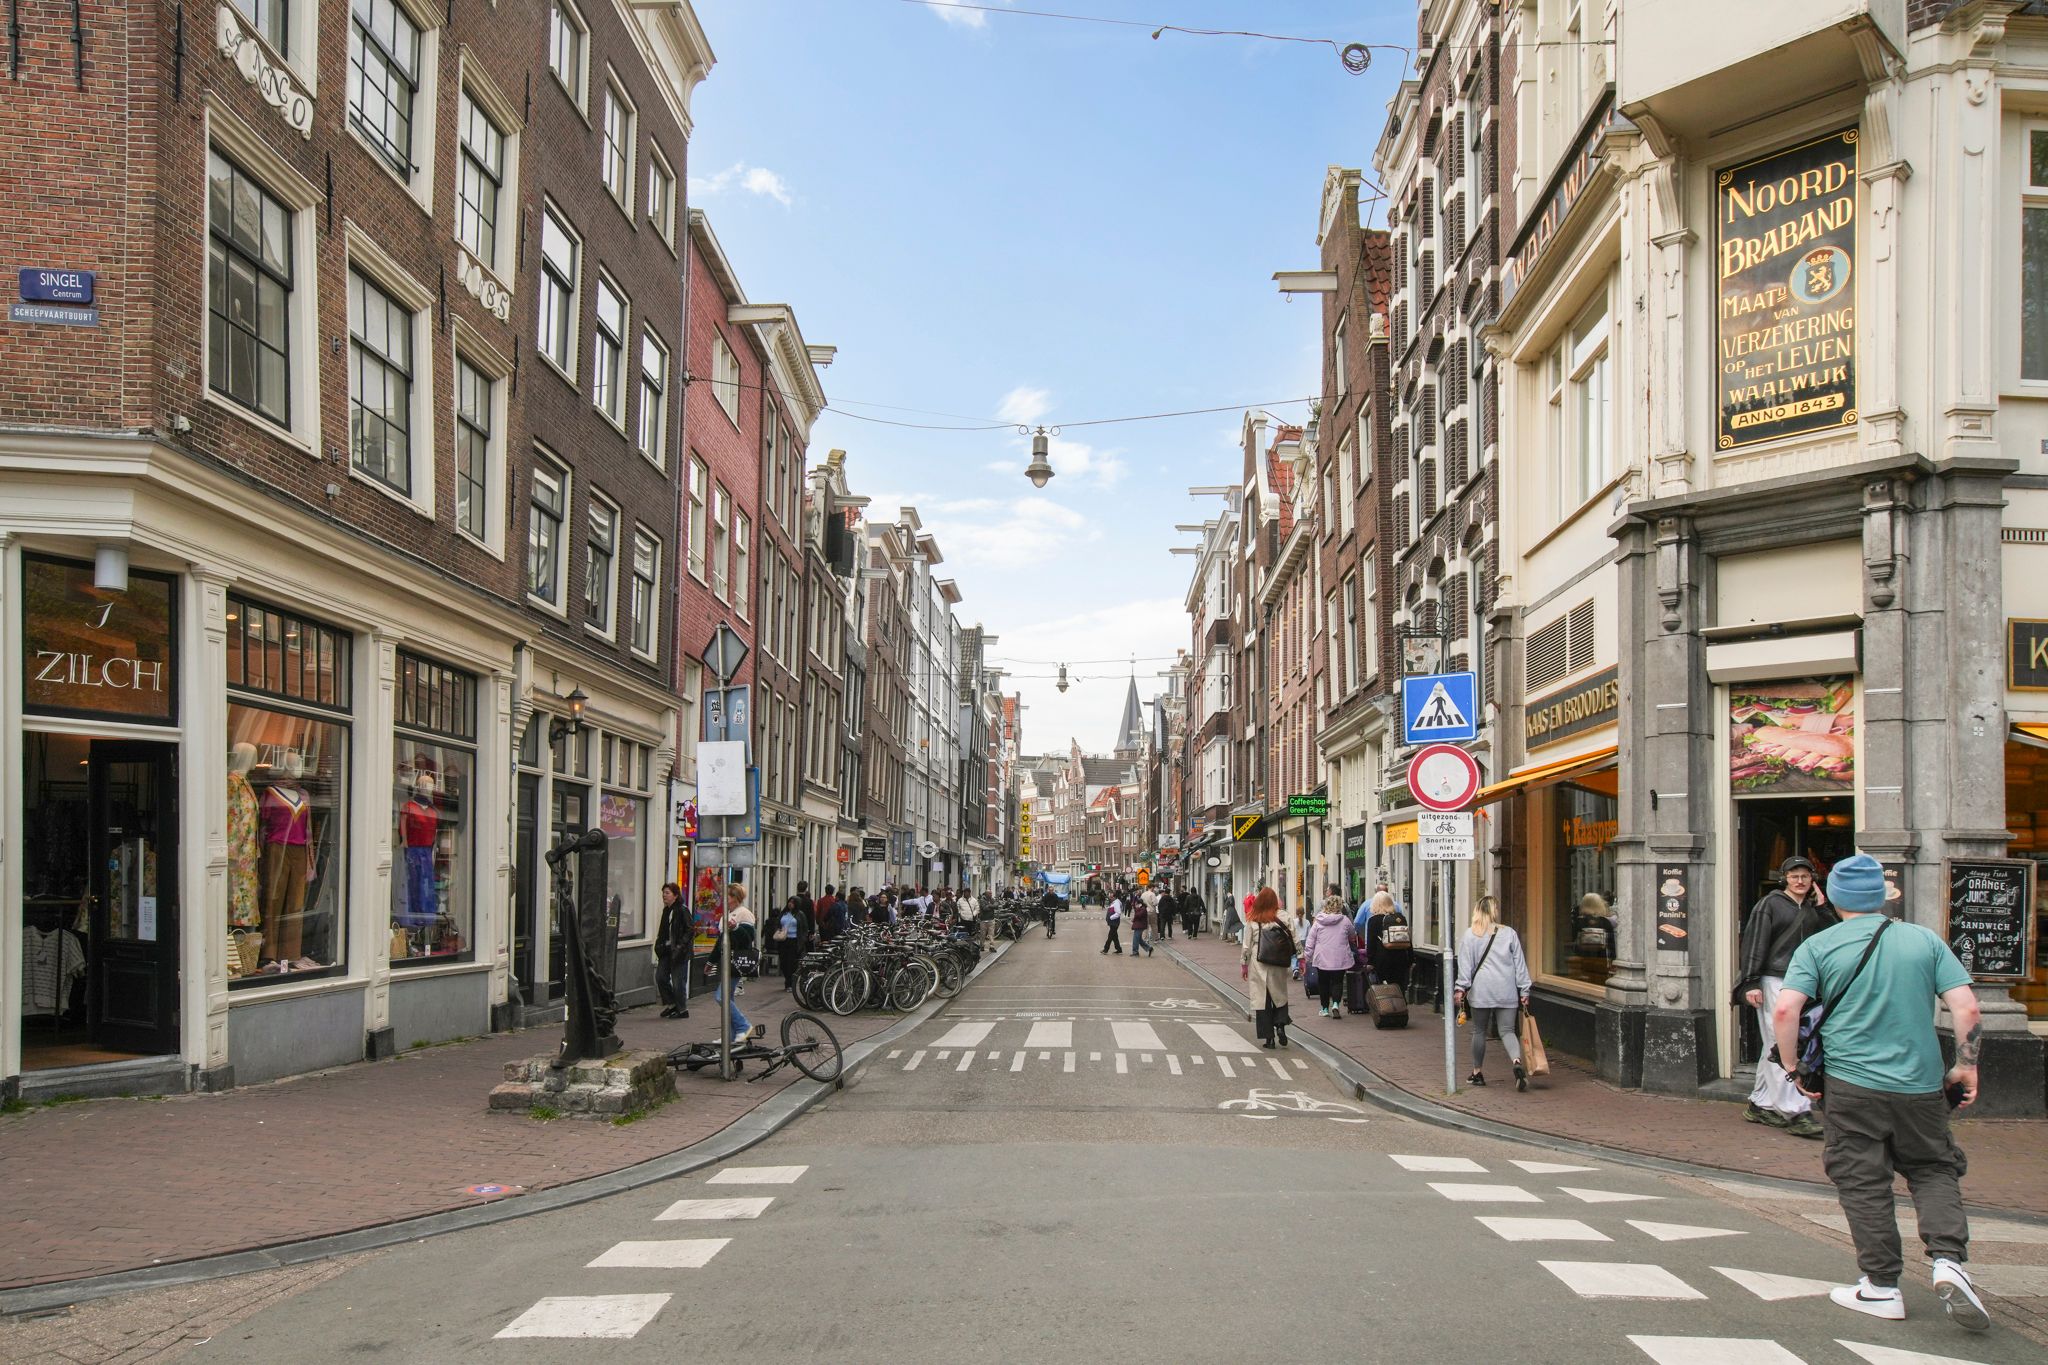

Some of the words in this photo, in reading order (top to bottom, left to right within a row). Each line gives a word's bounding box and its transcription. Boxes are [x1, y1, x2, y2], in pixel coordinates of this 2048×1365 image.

[1727, 161, 1855, 224] NOORD-
[1722, 197, 1853, 279] BRABAND
[40, 272, 83, 288] SINGEL
[52, 289, 82, 298] Centrum
[14, 307, 93, 321] SCHEEPVAARTBUURT
[1774, 306, 1799, 320] VAN
[1723, 308, 1854, 359] VERZEKERING
[1724, 360, 1746, 374] OP
[1745, 362, 1775, 380] HET
[1777, 334, 1851, 372] LEVEN
[1728, 365, 1847, 405] WAALWIJK
[1738, 407, 1786, 426] ANNO
[1794, 396, 1836, 415] 1843
[35, 649, 162, 692] ZILCH
[1526, 708, 1549, 738] KAAS
[1550, 702, 1563, 729] EN
[1564, 678, 1619, 724] BROODJES
[1290, 797, 1326, 807] Coffeeshop
[1290, 806, 1308, 814] Green
[1308, 806, 1326, 814] Place
[1022, 803, 1030, 855] HOTEL
[1662, 868, 1683, 876] Koffie
[1969, 869, 1991, 880] Always
[1993, 869, 2008, 878] Fresh
[1968, 878, 2006, 891] ORANGE
[1966, 890, 1990, 904] JUICE
[1659, 911, 1686, 919] Panini's
[1961, 921, 2011, 931] SANDWICH
[1977, 931, 1995, 943] Hot
